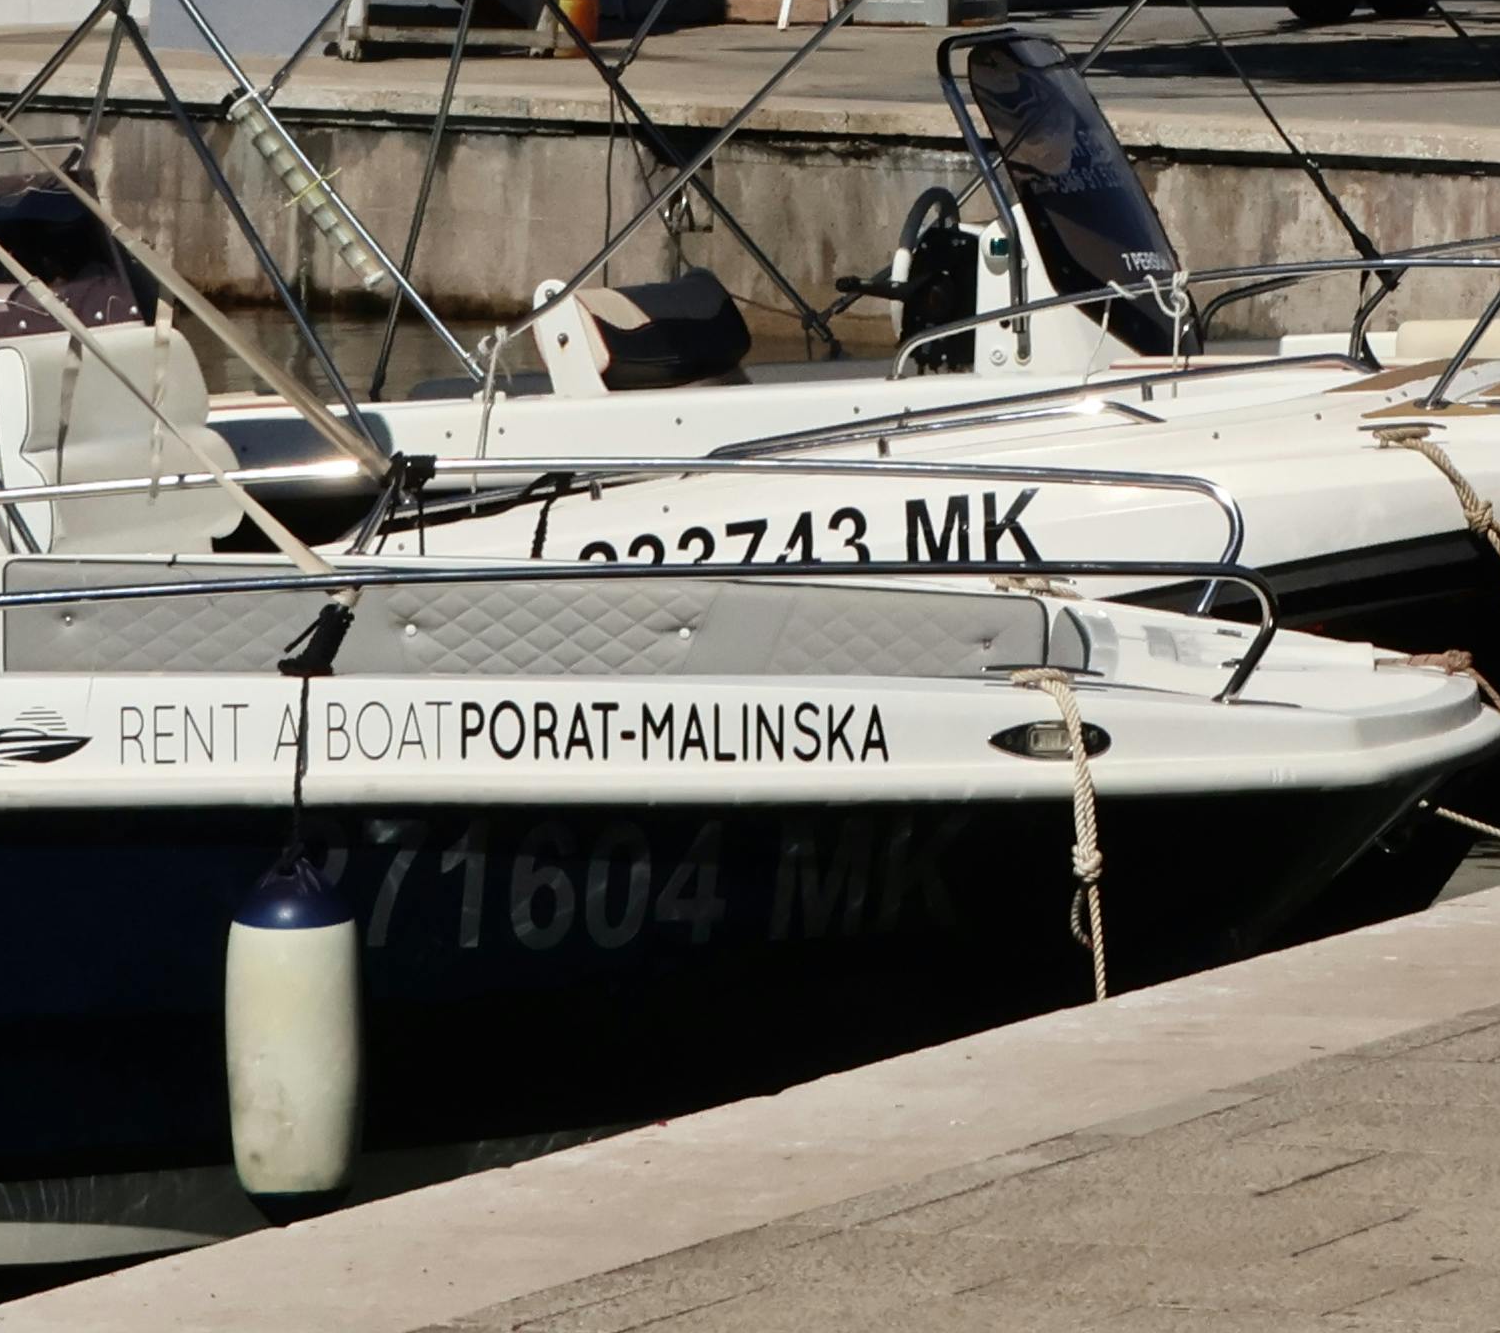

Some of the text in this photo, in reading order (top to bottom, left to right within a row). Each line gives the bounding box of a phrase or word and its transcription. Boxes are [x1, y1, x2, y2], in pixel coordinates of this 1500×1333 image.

[905, 486, 1041, 564] MK
[119, 704, 250, 765] RENT
[273, 703, 305, 762] A
[766, 804, 975, 941] MK
